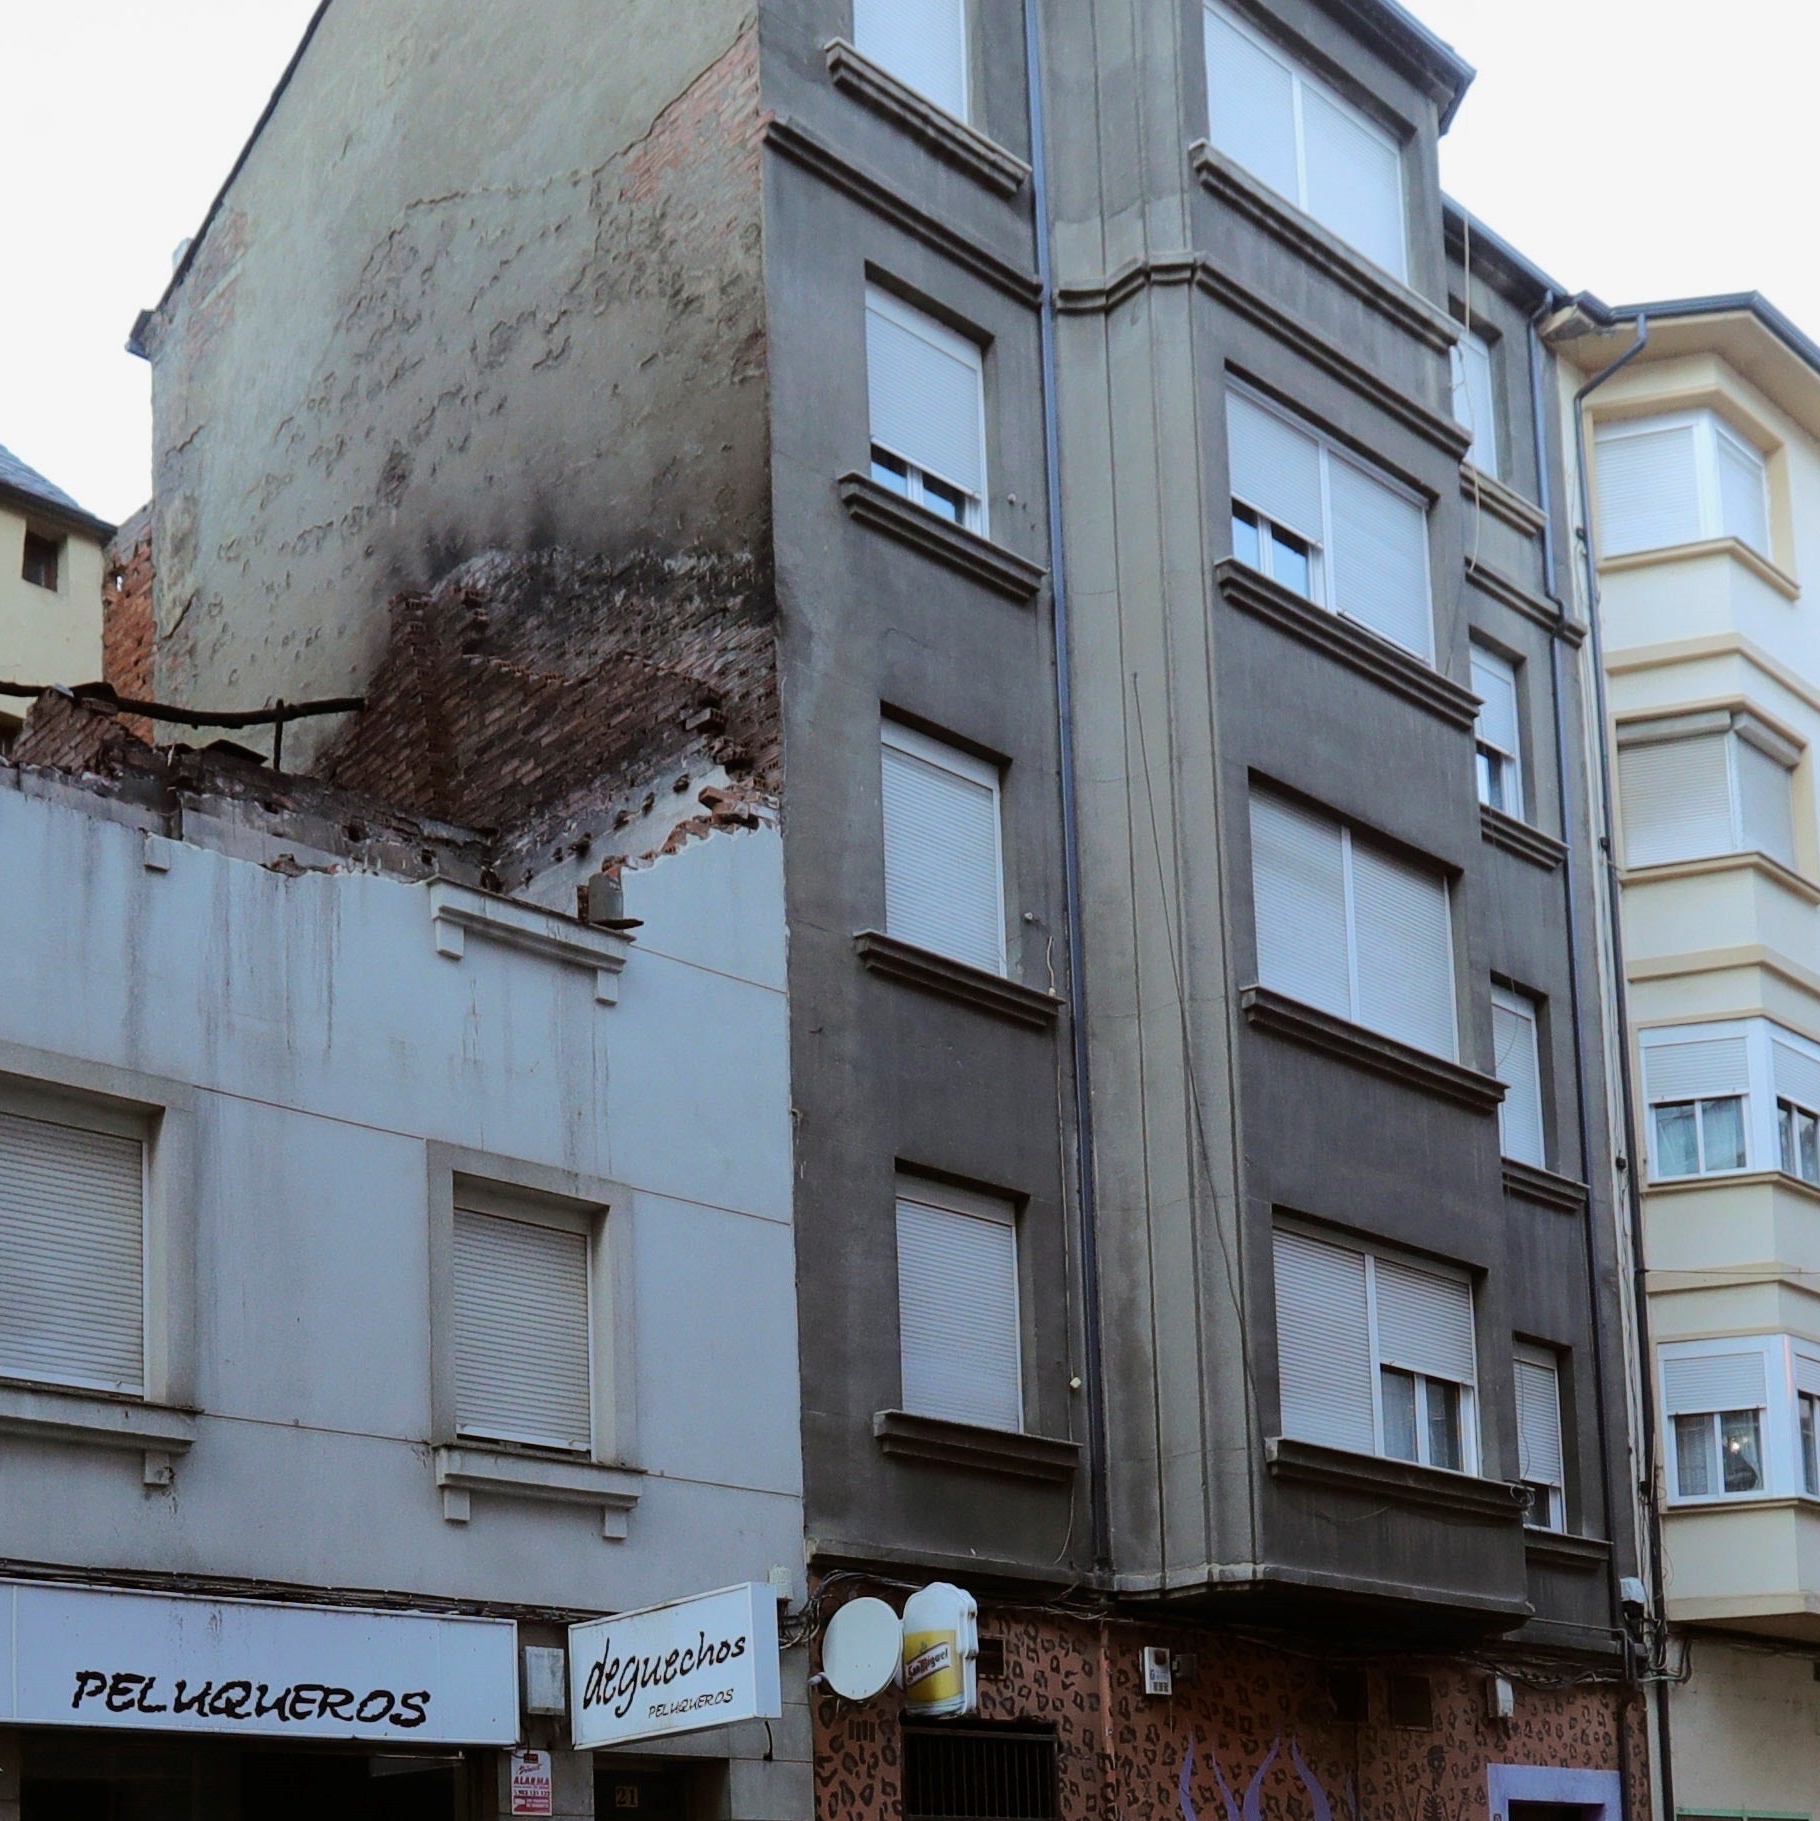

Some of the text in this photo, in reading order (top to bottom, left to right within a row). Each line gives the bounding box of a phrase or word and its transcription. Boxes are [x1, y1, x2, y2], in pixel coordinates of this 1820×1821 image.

[582, 1631, 746, 1718] deguechos
[71, 1670, 430, 1727] PELUQUEROS
[648, 1688, 734, 1720] PELUQUEROS
[617, 1787, 637, 1806] 21
